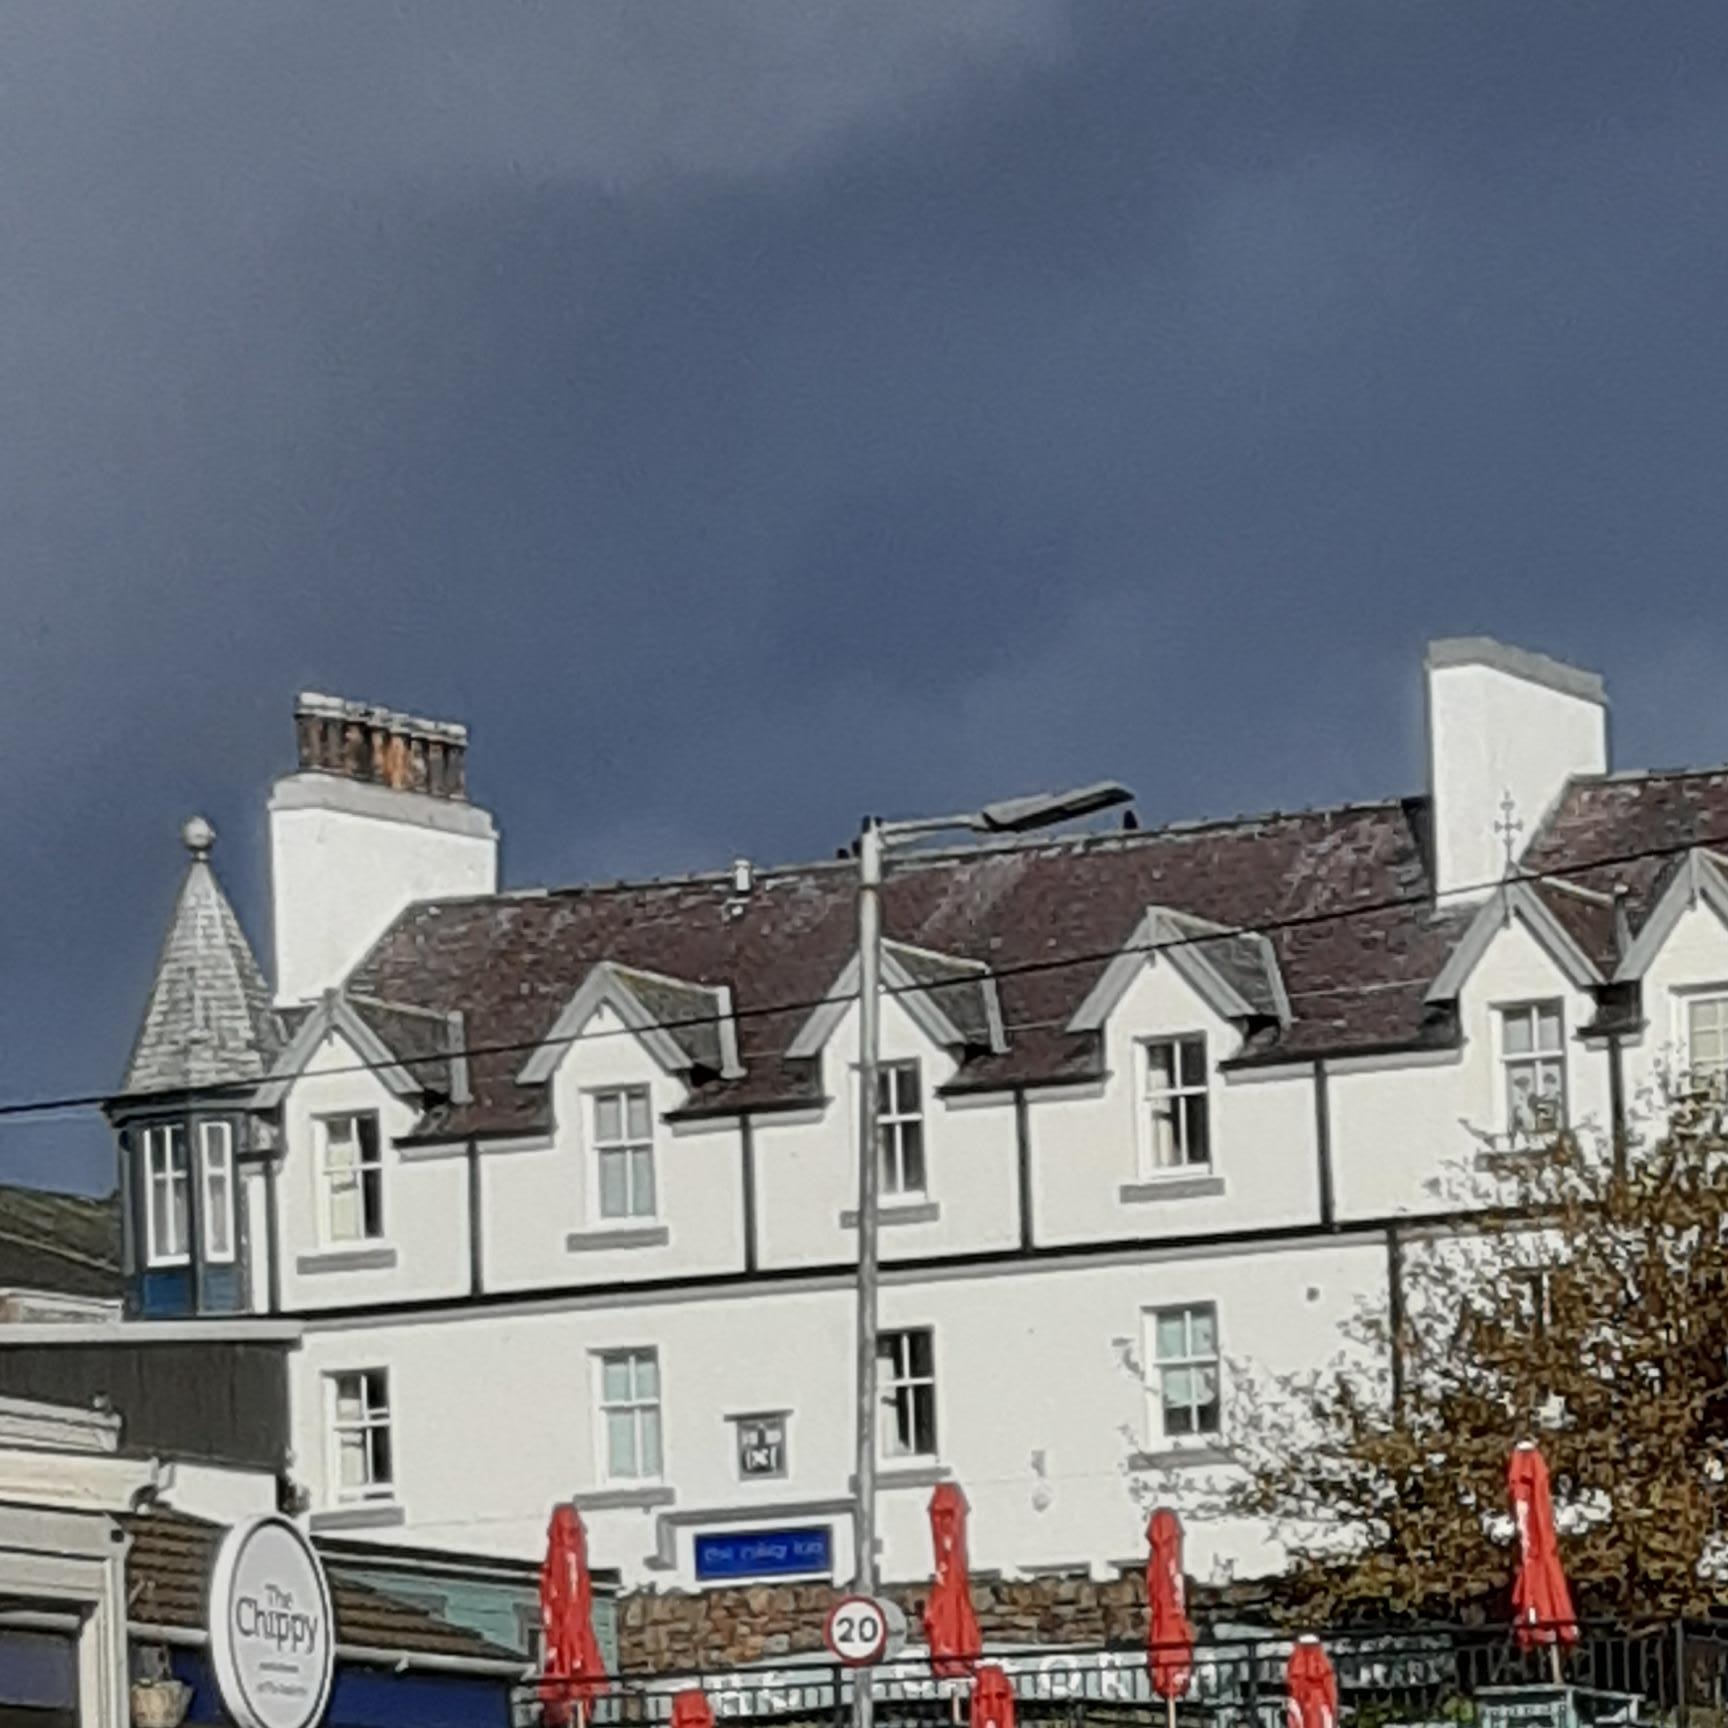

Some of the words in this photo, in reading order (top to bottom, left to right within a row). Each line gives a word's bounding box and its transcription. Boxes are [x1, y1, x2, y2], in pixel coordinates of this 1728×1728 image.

[264, 1583, 293, 1609] The
[236, 1597, 318, 1654] Chippy
[836, 1616, 879, 1643] 20
